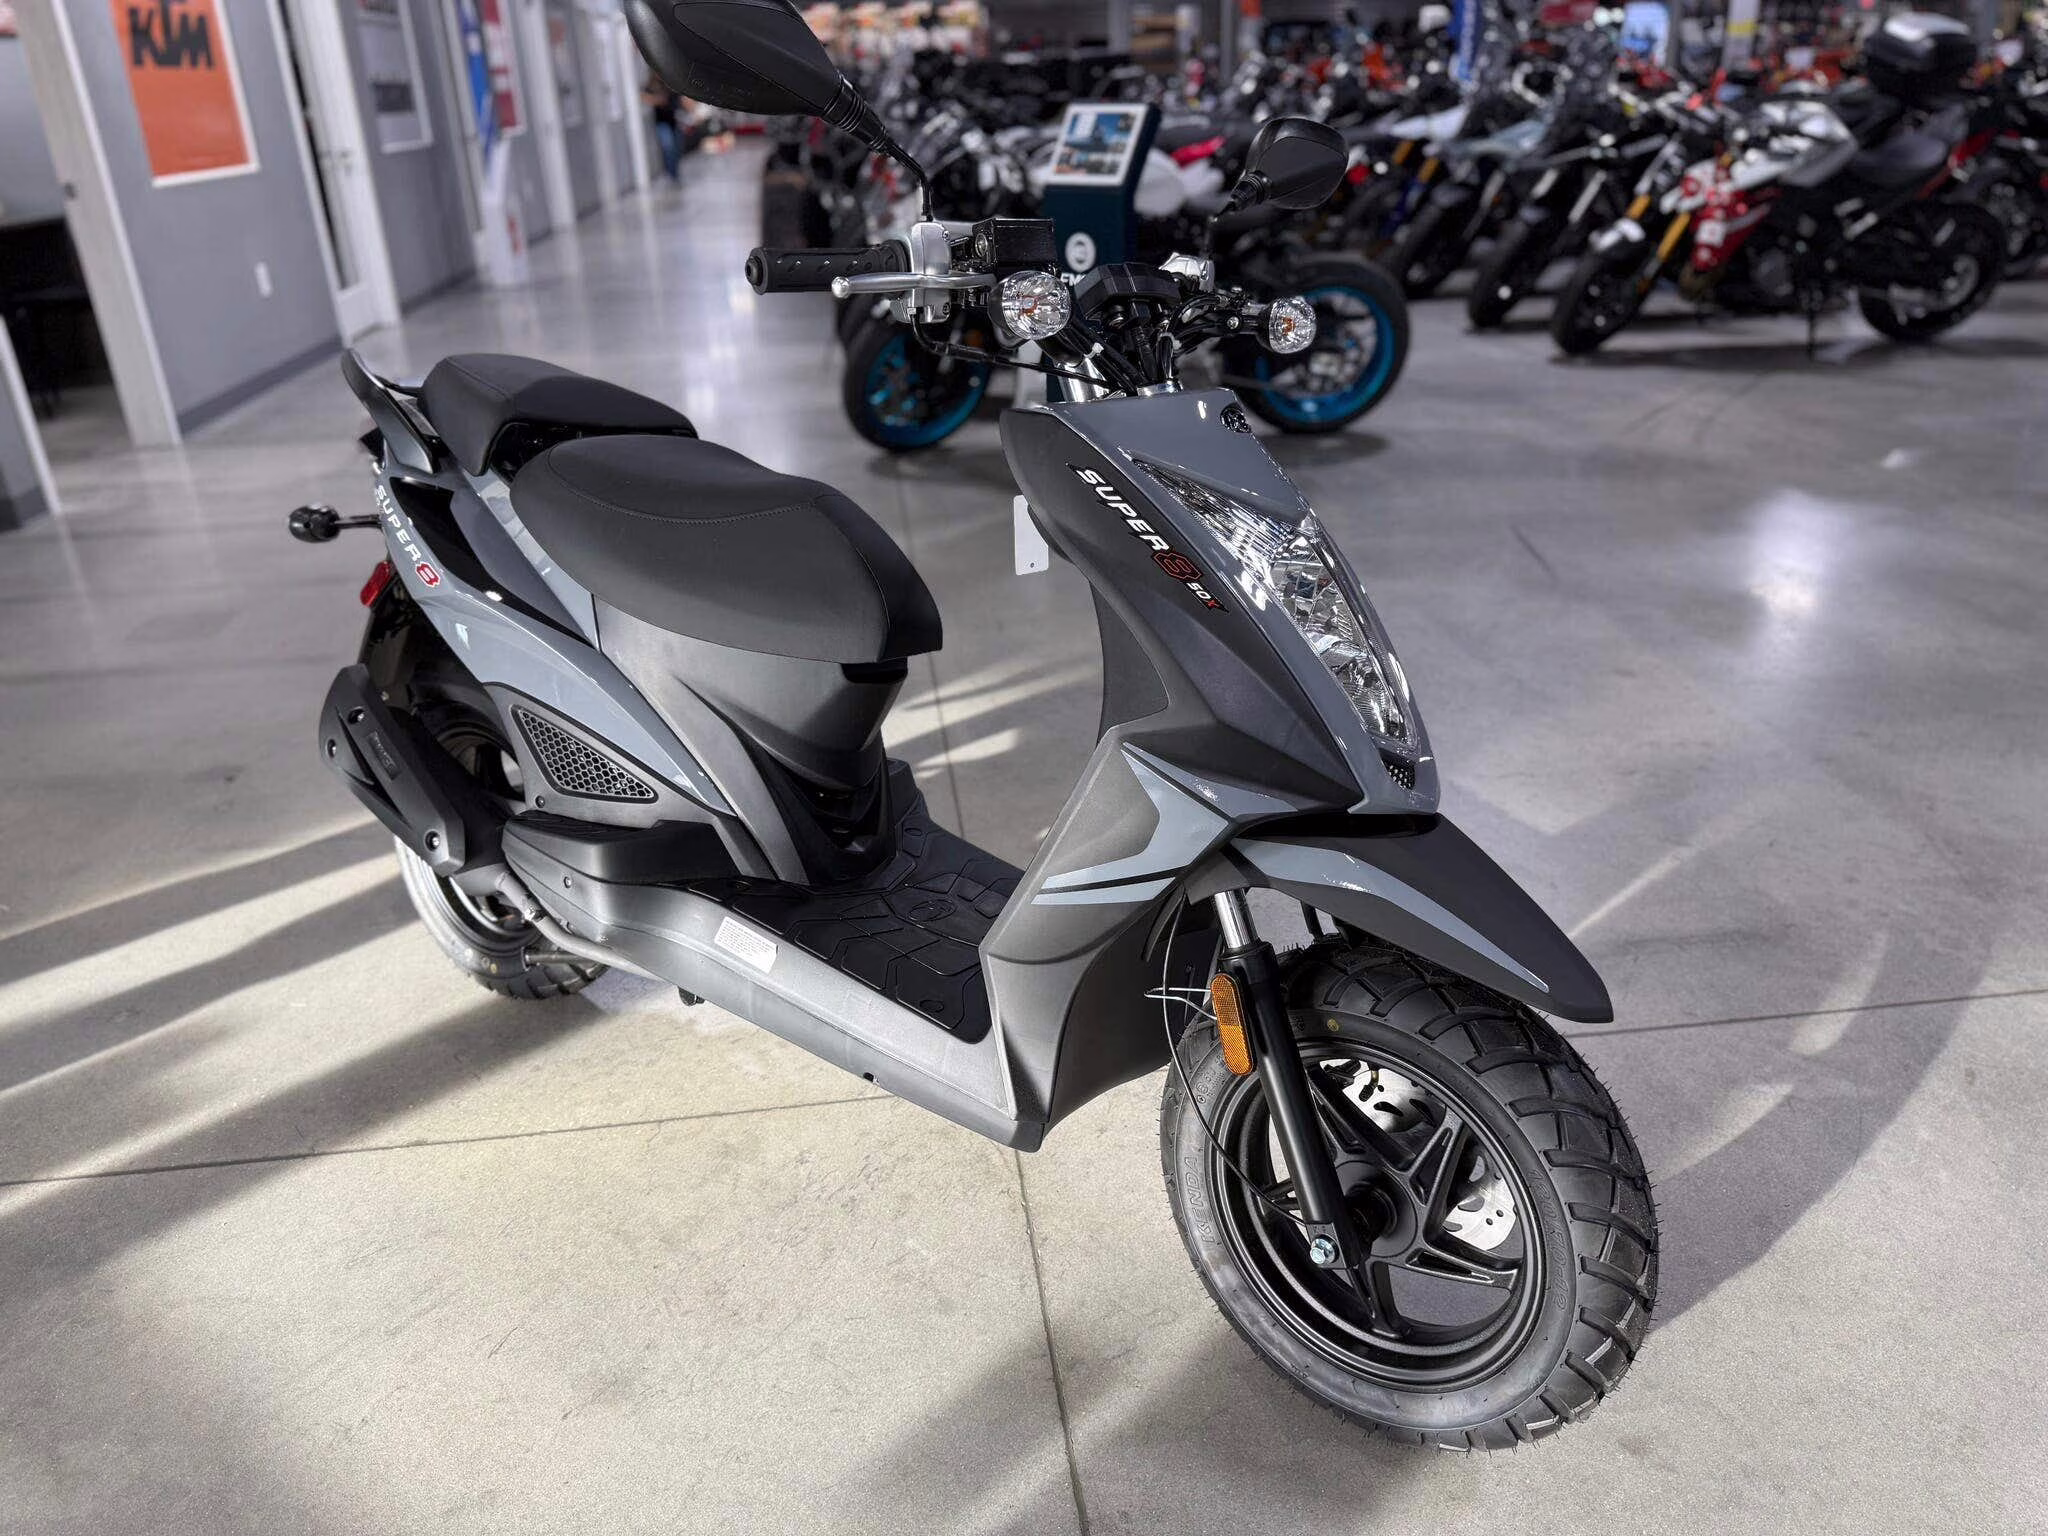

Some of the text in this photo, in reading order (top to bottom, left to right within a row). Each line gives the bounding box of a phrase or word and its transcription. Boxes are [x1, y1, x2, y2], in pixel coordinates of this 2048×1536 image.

[129, 0, 214, 68] KTM
[379, 485, 421, 561] SUPER
[1076, 469, 1170, 550] SUPER
[1185, 1156, 1216, 1244] KENDA
